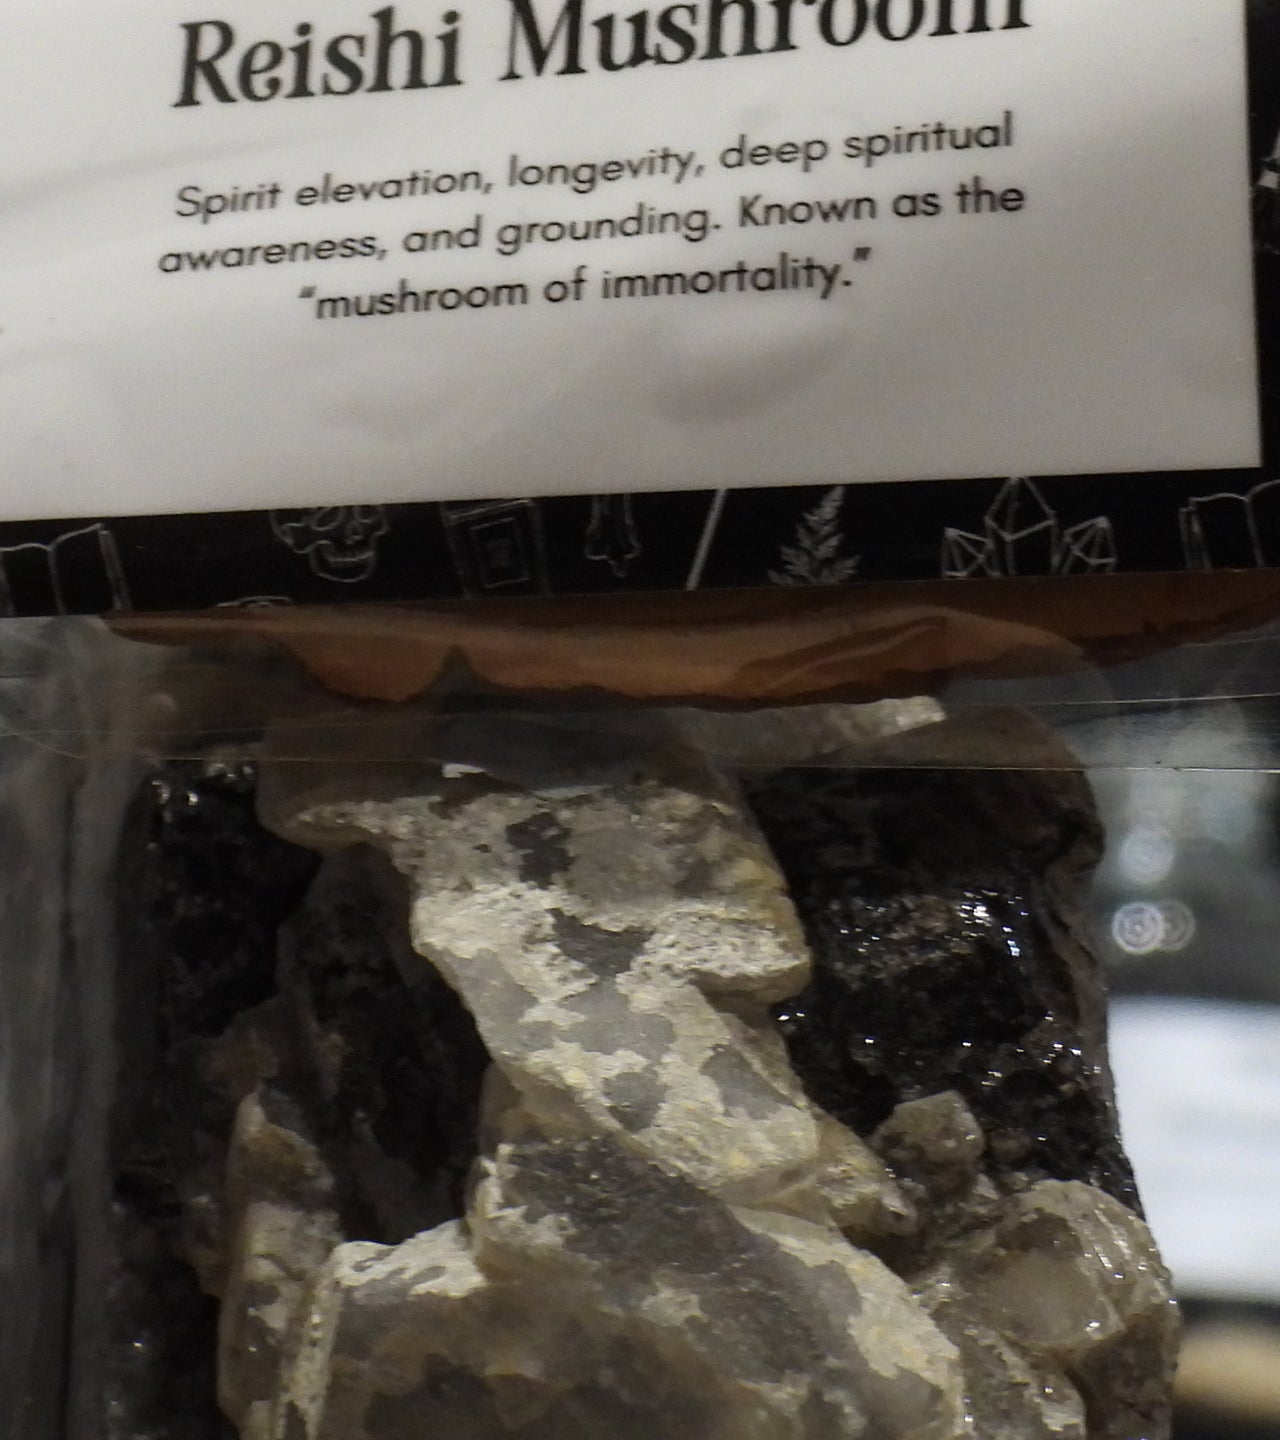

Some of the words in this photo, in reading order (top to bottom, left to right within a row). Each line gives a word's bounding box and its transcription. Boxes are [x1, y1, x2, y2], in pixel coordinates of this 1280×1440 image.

[171, 4, 464, 109] Reishi
[175, 182, 283, 225] Spirit
[295, 172, 493, 207] elevation,
[508, 147, 705, 195] longevity,
[719, 133, 829, 173] deep
[843, 109, 1013, 168] spiritual
[158, 235, 388, 274] awareness,
[402, 214, 483, 253] and
[496, 201, 721, 257] grounding.
[738, 194, 877, 228] Known
[892, 191, 942, 219] as
[954, 175, 1027, 215] the
[543, 264, 588, 304] of
